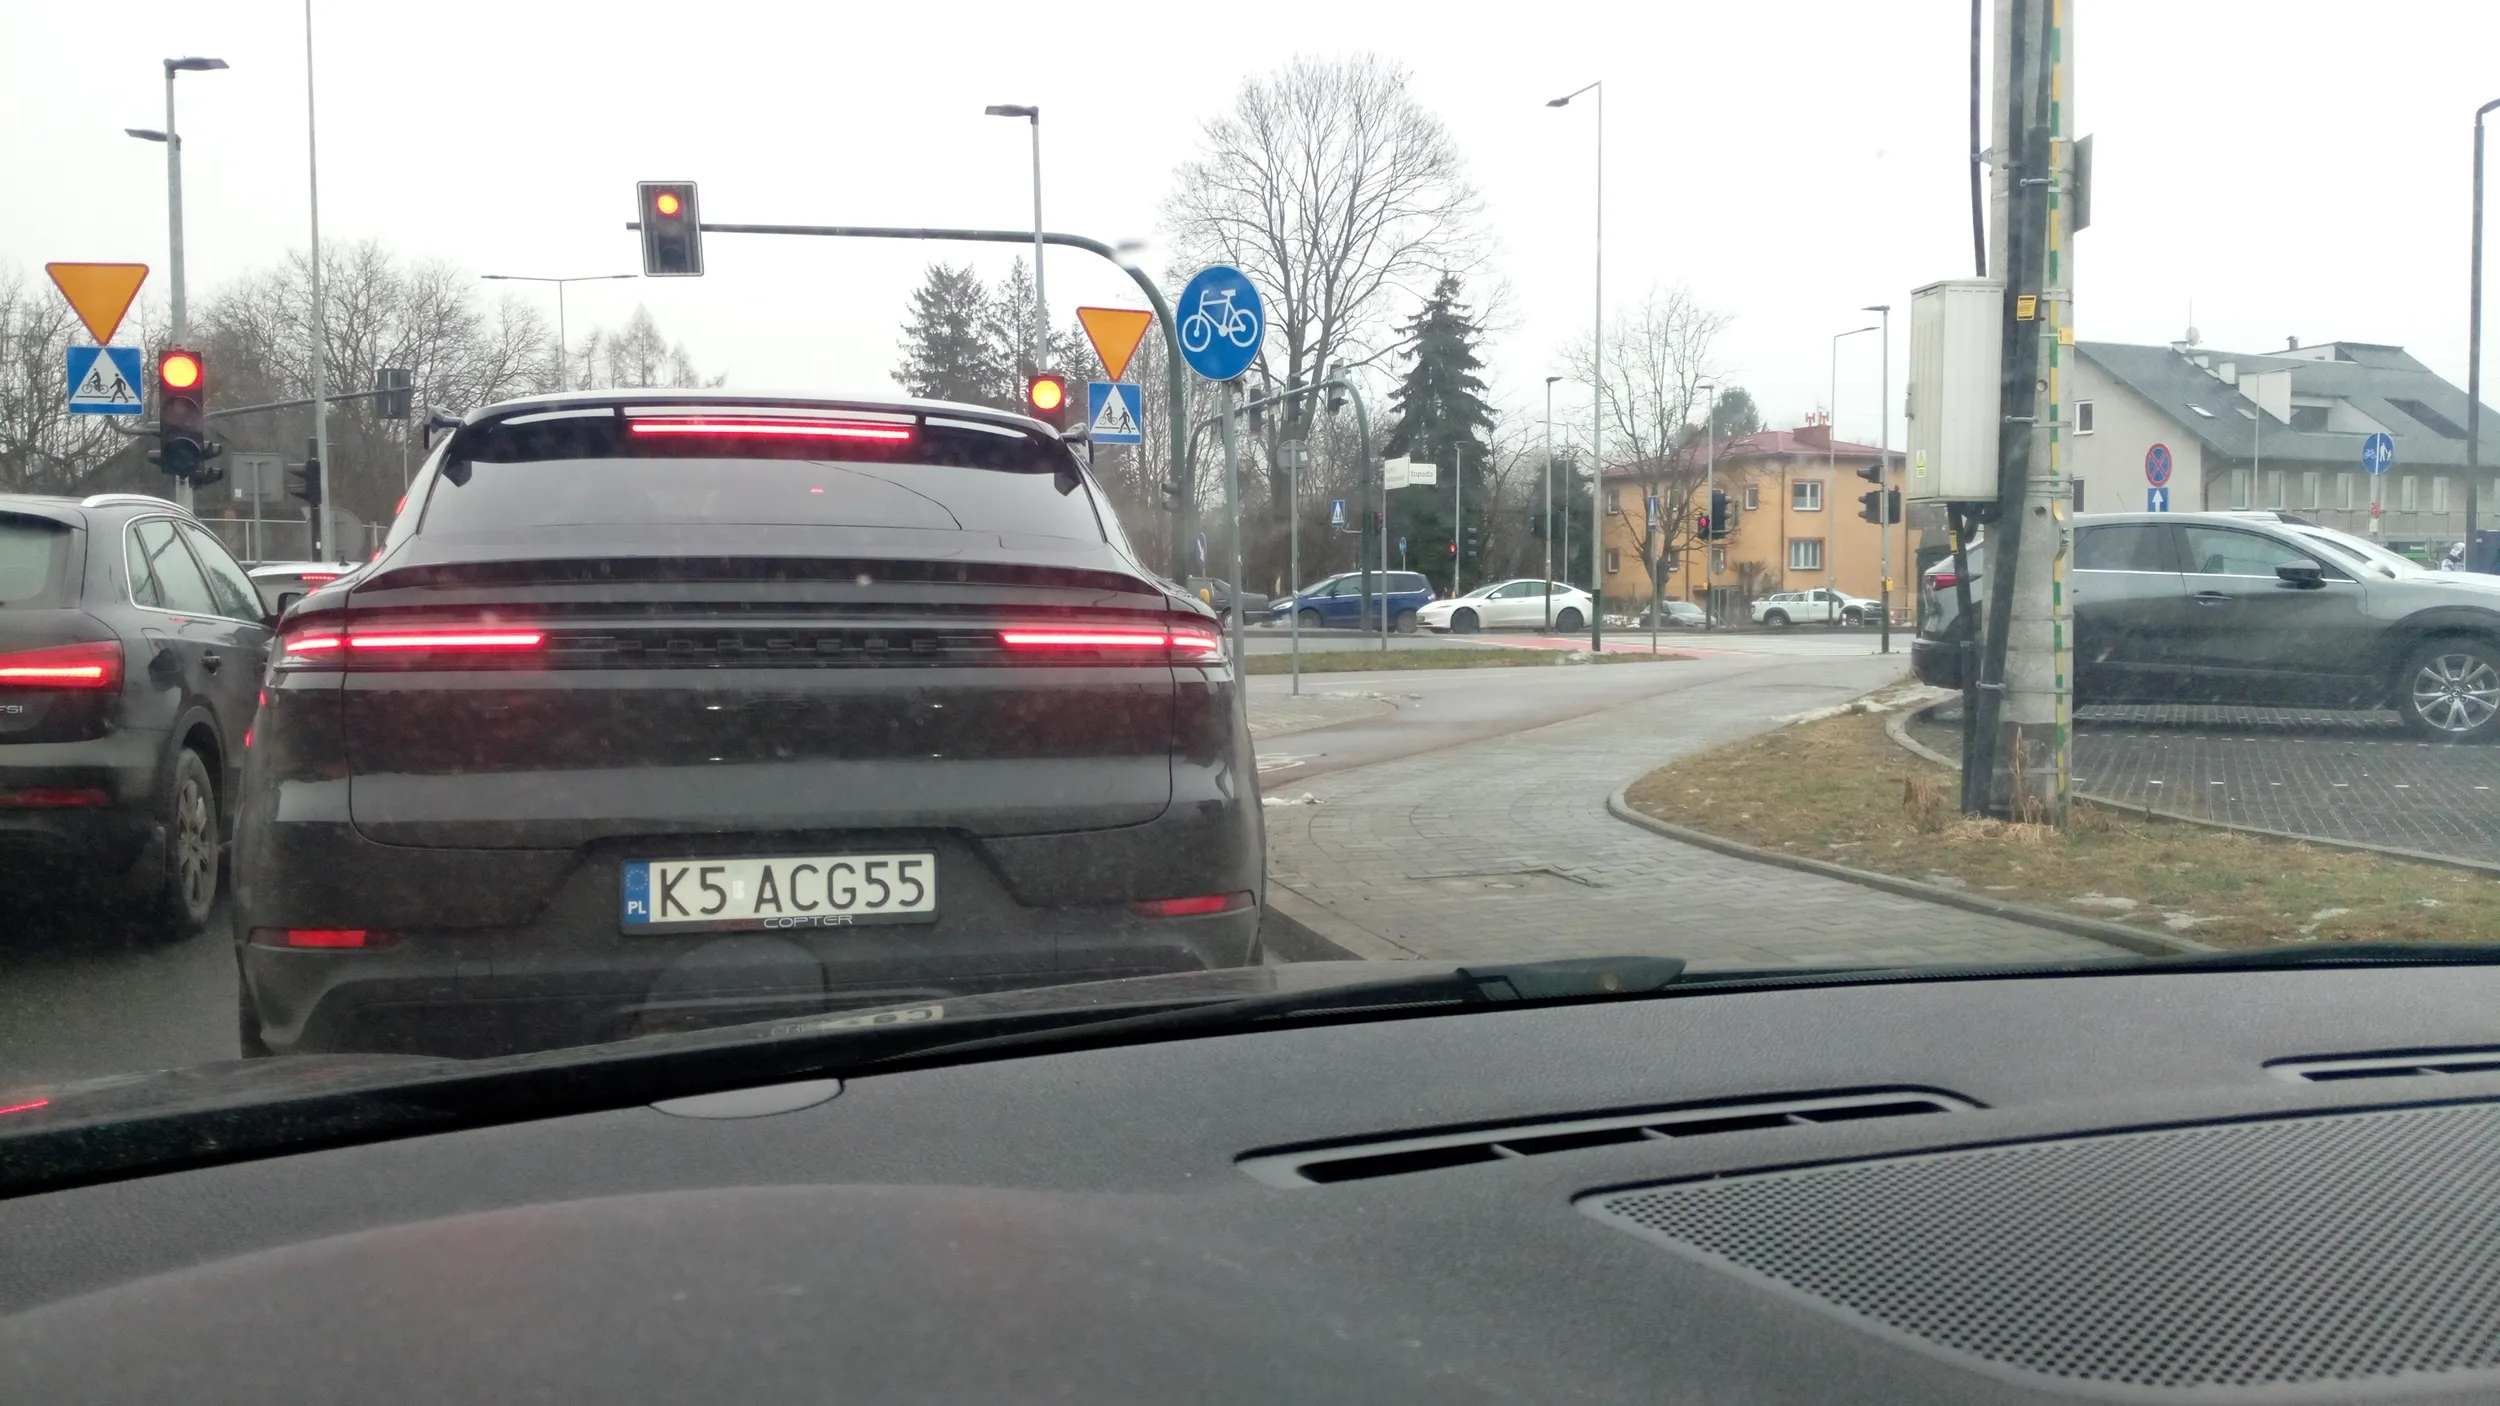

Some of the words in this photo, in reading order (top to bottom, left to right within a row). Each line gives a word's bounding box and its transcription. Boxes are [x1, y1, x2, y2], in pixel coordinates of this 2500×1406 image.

[660, 866, 728, 917] K5
[754, 860, 924, 914] ACG55
[628, 901, 646, 915] PL
[764, 914, 853, 929] COPTER
